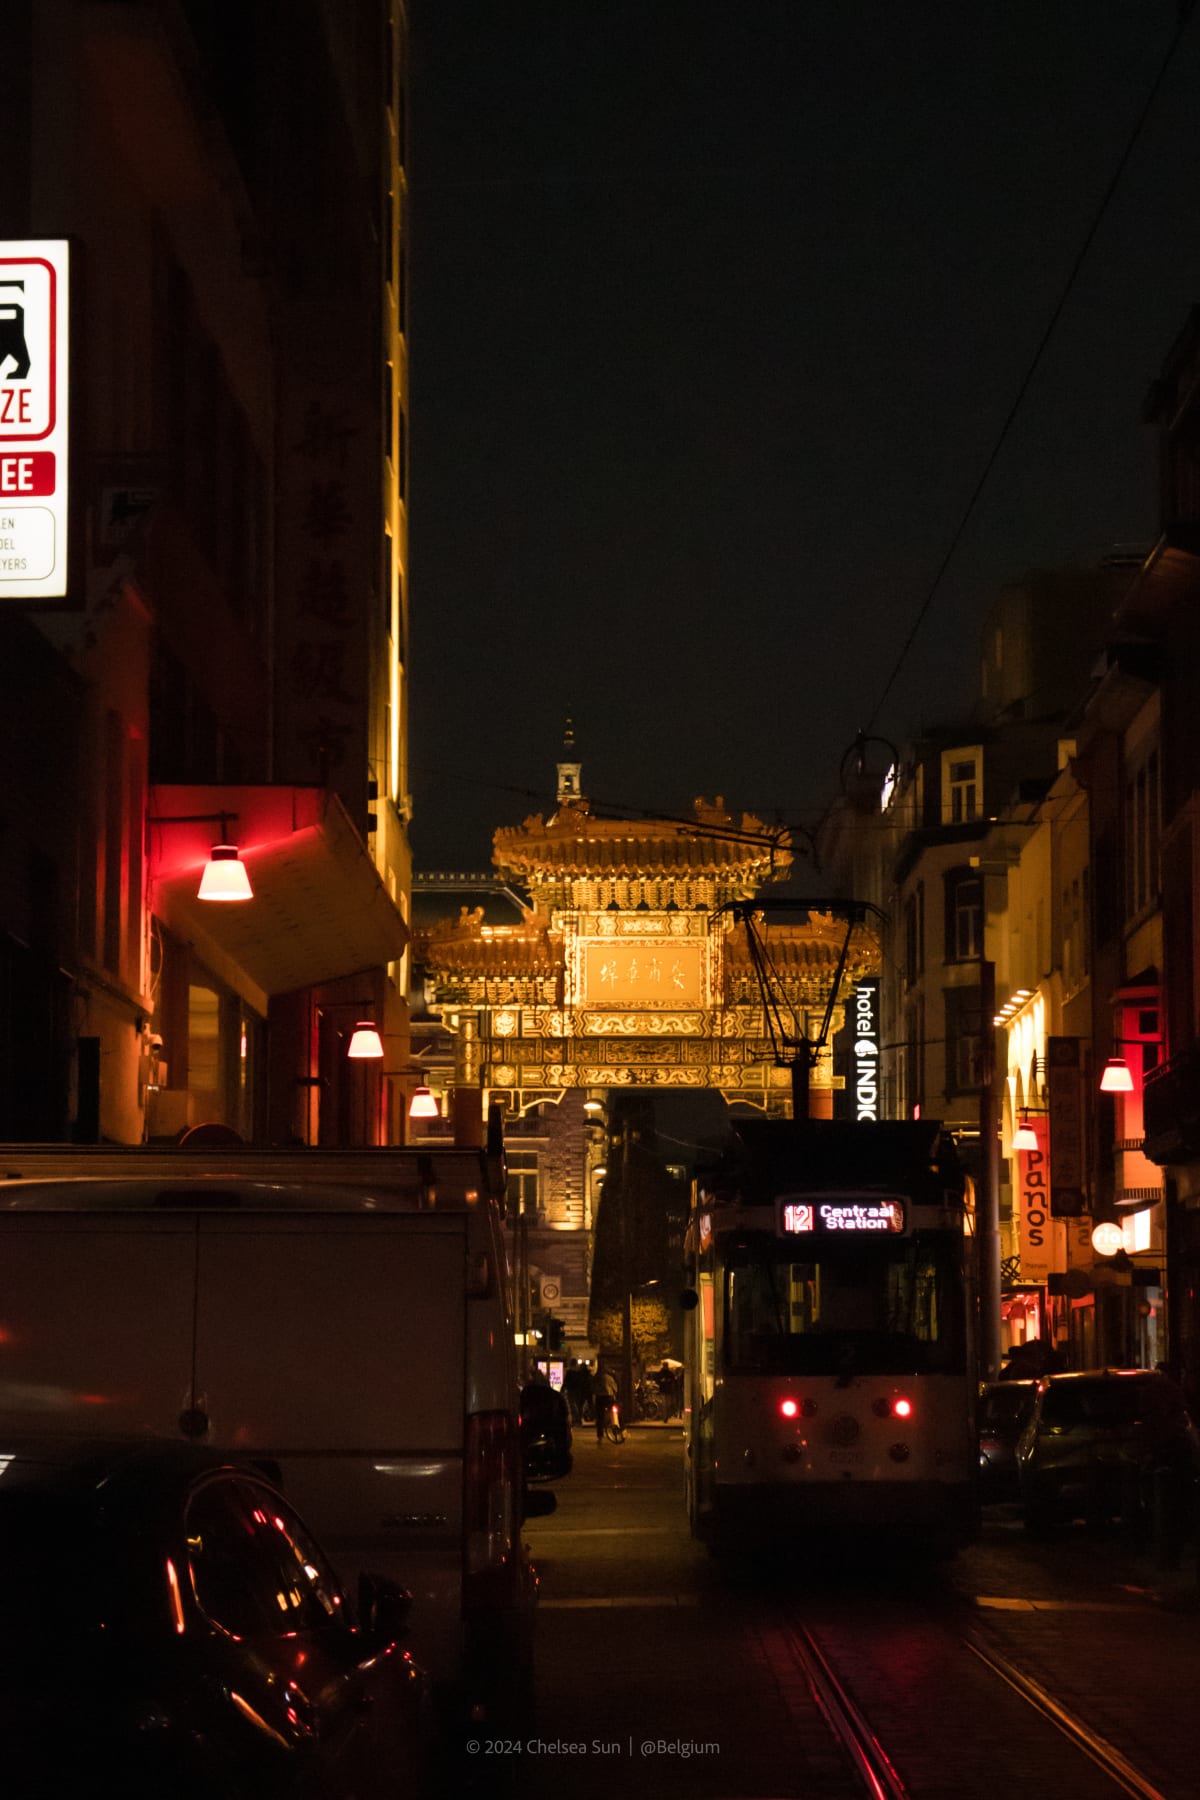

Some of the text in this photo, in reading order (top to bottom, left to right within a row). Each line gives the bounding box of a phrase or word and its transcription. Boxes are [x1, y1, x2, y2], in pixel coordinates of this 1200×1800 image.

[857, 987, 876, 1037] hotel
[820, 1204, 895, 1218] Centraal
[1024, 1151, 1048, 1246] Panos
[826, 1217, 888, 1230] Station
